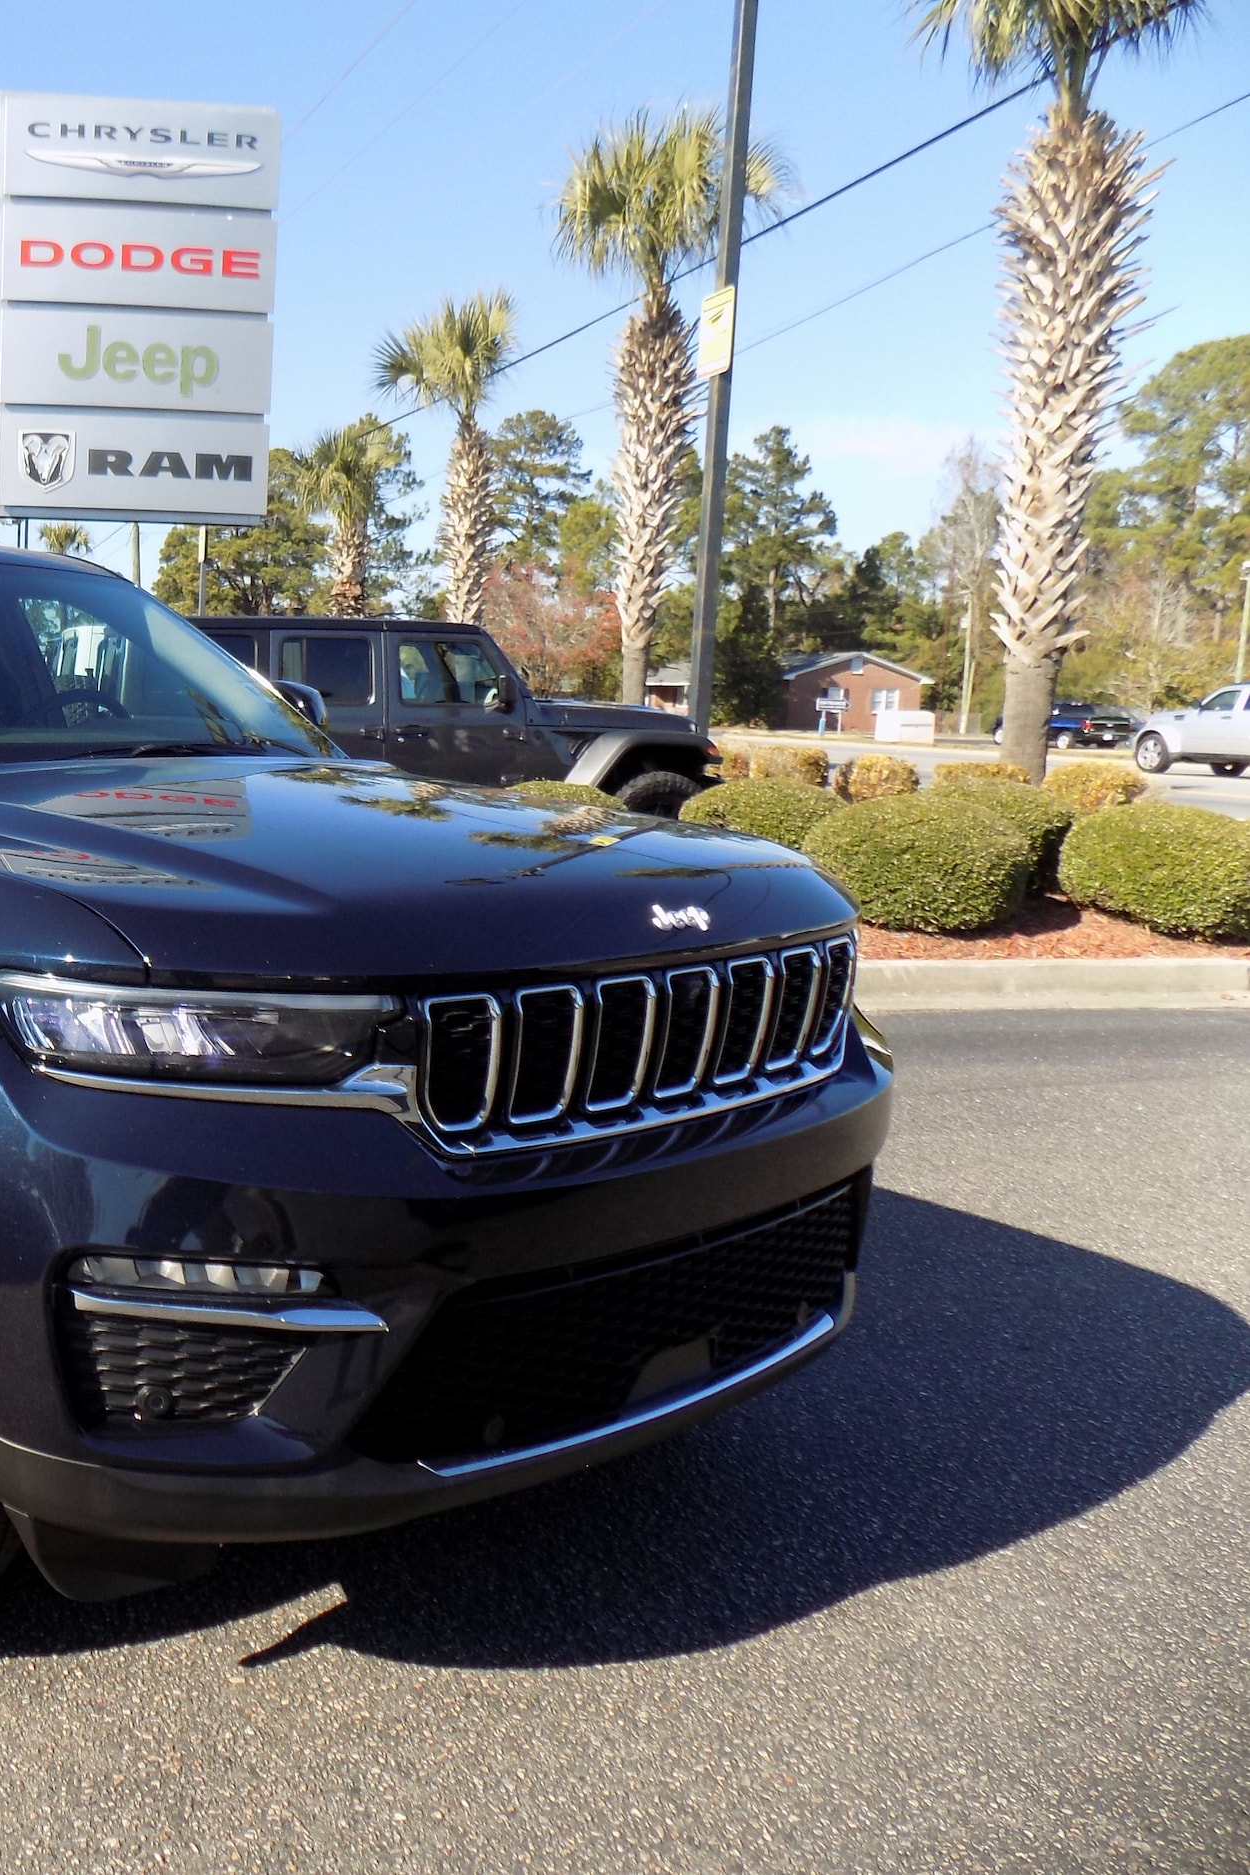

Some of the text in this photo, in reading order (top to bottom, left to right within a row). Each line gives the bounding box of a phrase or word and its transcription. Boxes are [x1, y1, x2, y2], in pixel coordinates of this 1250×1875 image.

[27, 122, 258, 150] CHRYSLER
[20, 239, 260, 279] DODGE
[57, 325, 219, 396] Jeep
[87, 448, 253, 481] RAM
[651, 904, 710, 931] Jeep
